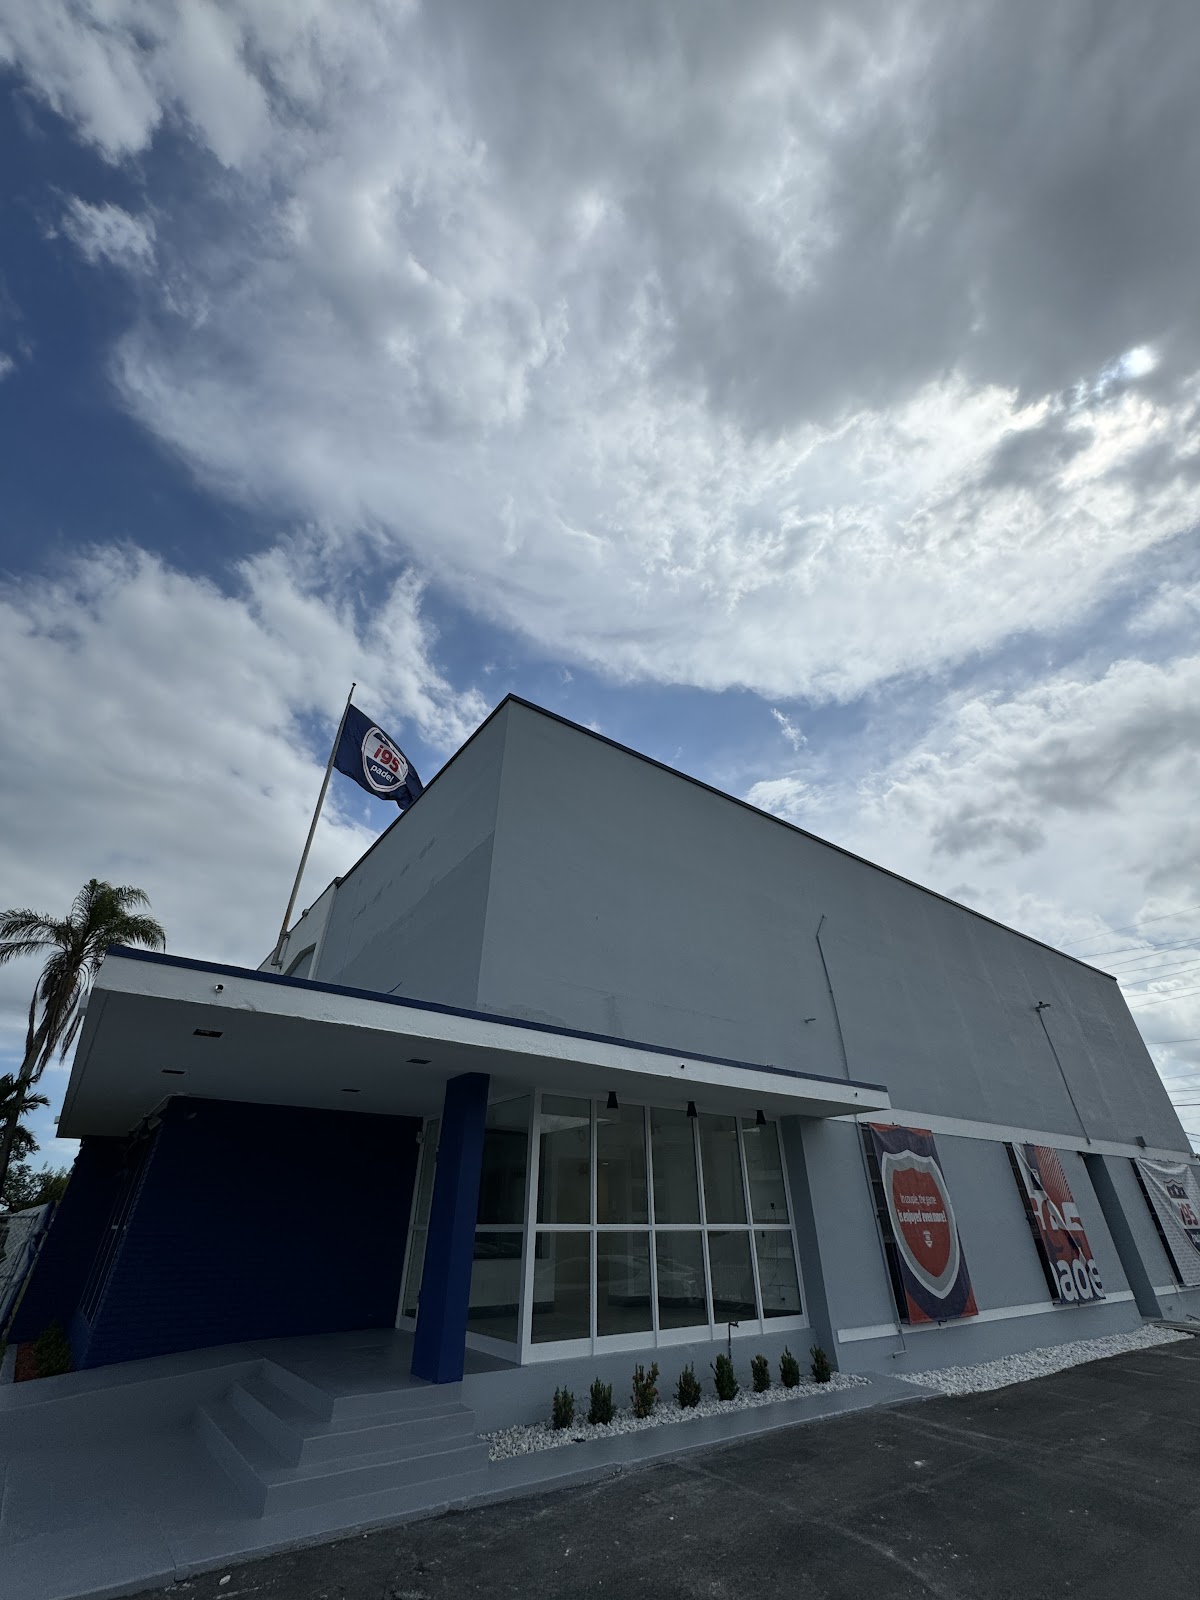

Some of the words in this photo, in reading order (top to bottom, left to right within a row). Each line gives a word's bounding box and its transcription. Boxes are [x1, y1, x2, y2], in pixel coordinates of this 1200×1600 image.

[373, 744, 400, 773] i95
[370, 765, 394, 783] padel
[897, 1209, 904, 1222] is
[903, 1209, 922, 1225] enjoyed
[921, 1212, 934, 1223] even
